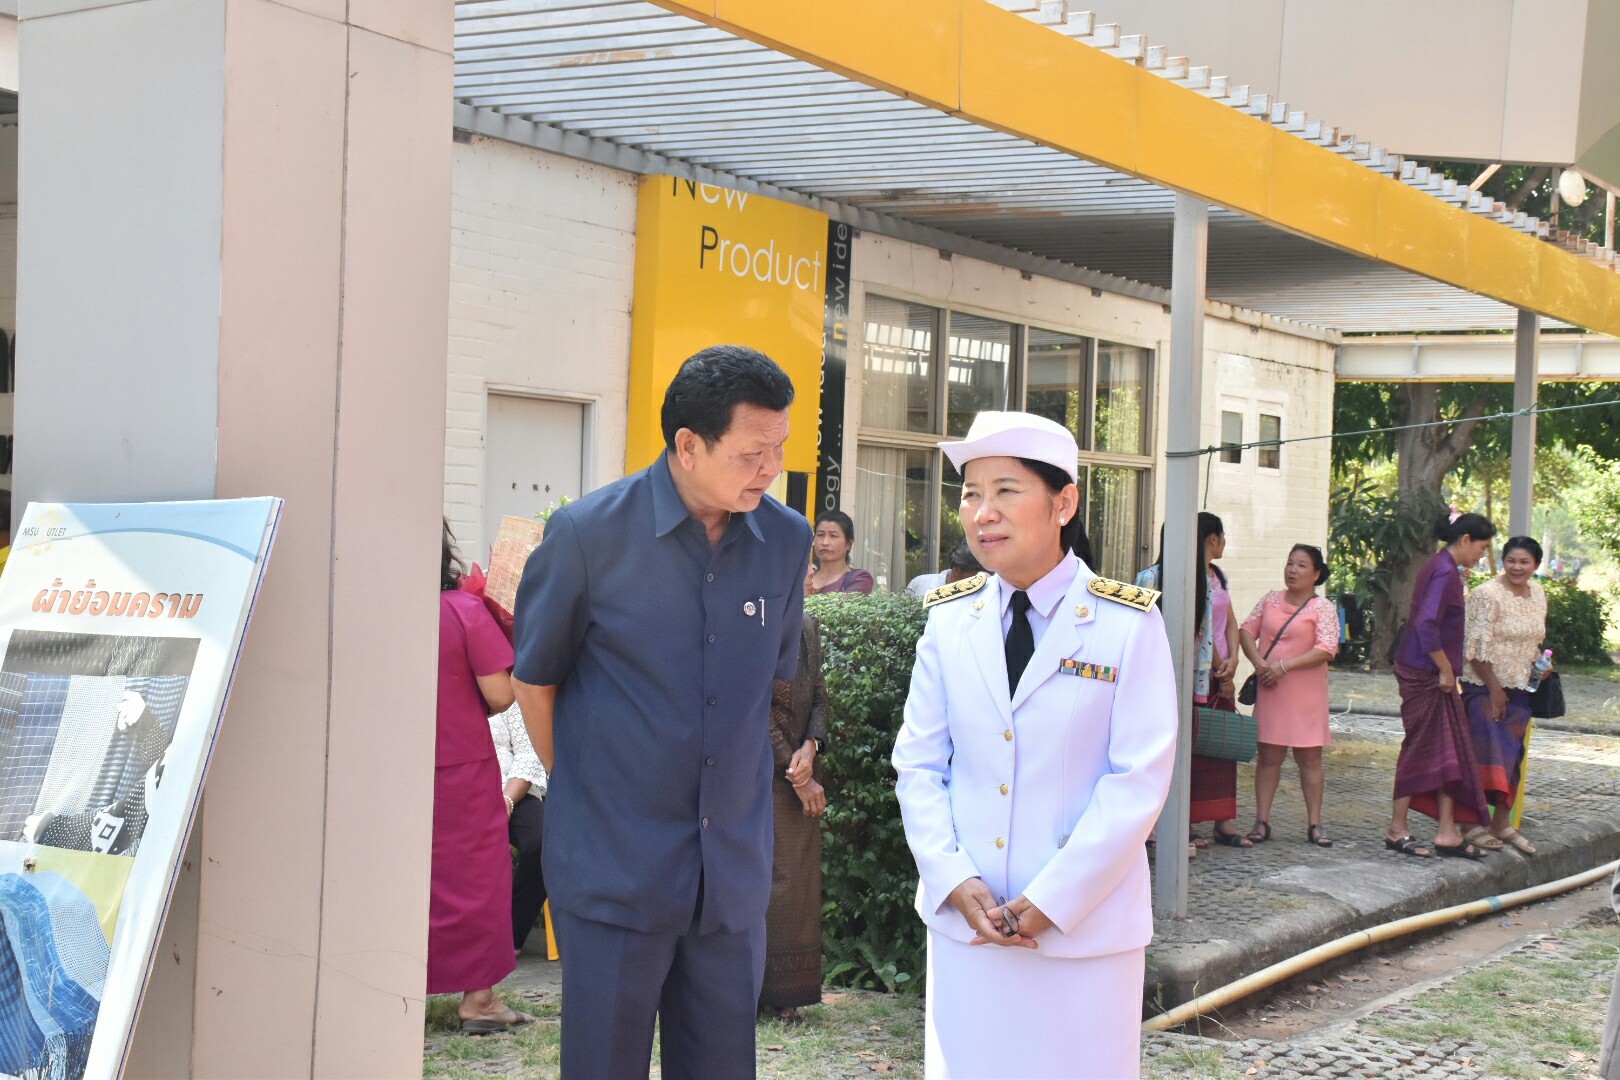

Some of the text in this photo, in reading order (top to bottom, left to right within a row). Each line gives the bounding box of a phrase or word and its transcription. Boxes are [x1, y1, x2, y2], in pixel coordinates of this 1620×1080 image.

[700, 225, 821, 292] Product
[833, 277, 847, 341] new
[22, 526, 40, 537] MSU
[31, 577, 204, 619] ผ้าย้อมคราม
